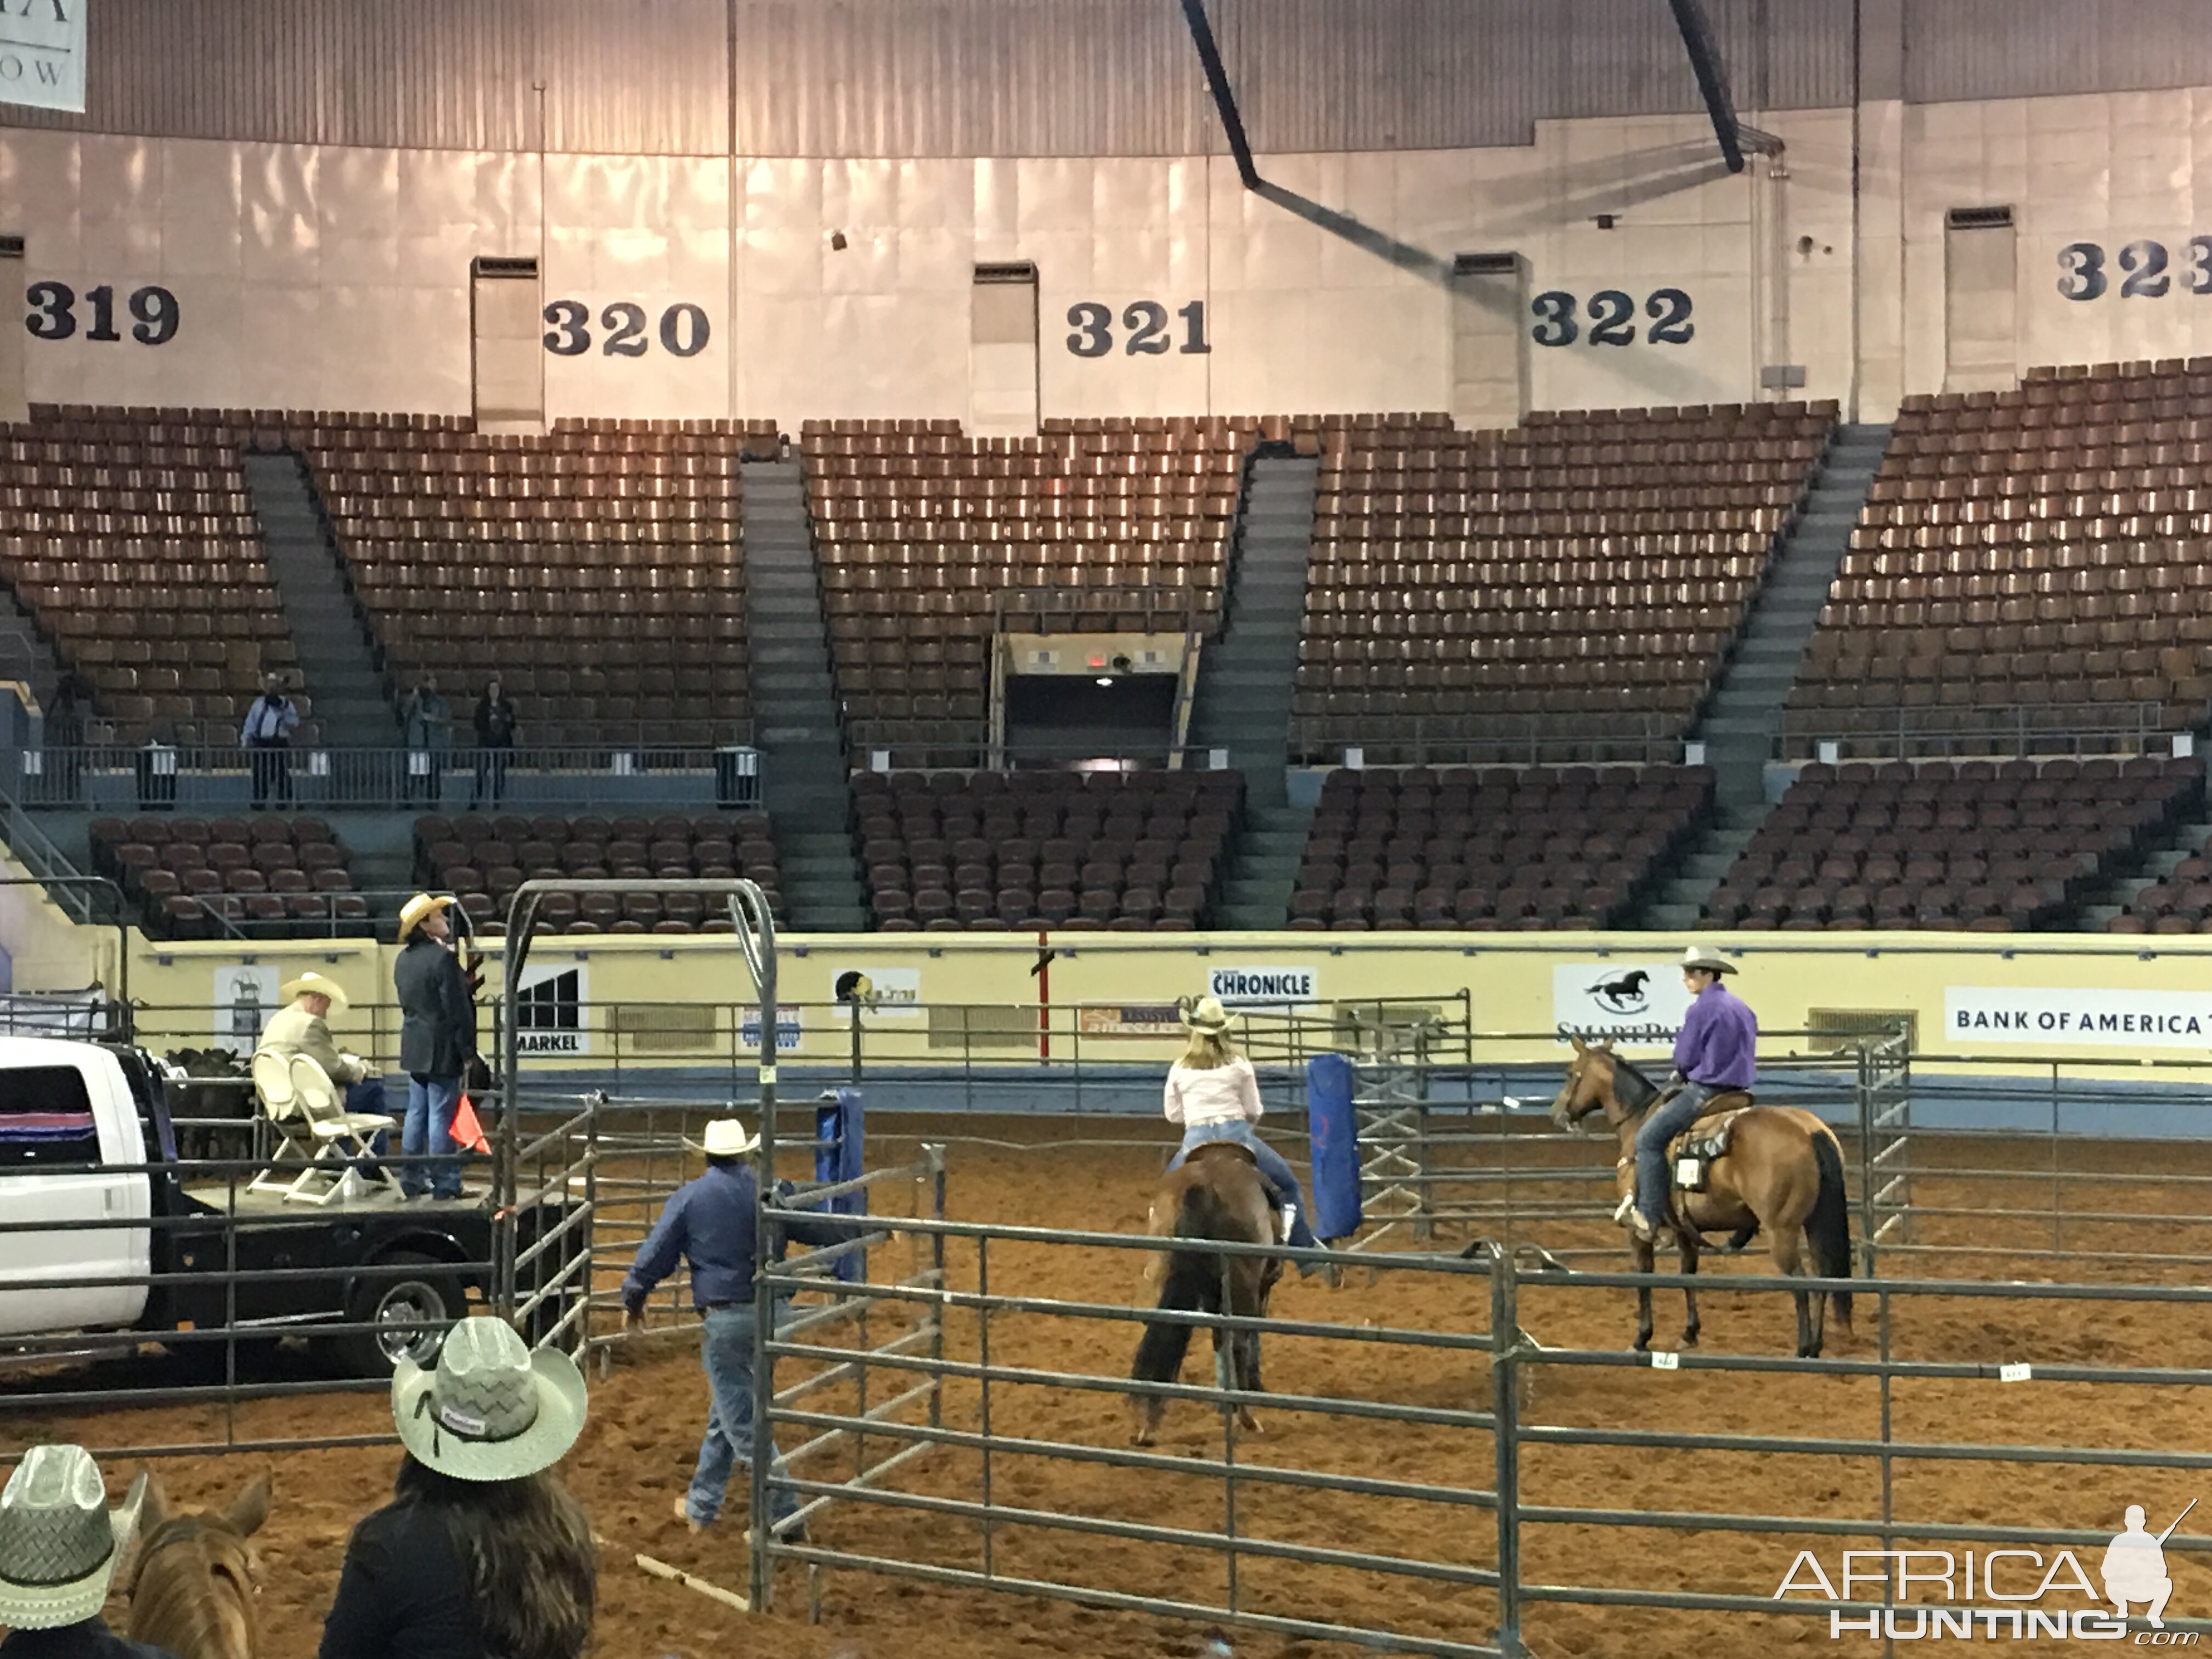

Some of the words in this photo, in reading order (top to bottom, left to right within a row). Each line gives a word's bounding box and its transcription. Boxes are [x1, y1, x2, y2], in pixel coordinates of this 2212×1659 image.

[26, 281, 179, 345] 319
[543, 300, 710, 357] 320
[1066, 300, 1211, 358] 321
[1531, 288, 1694, 347] 322
[1214, 974, 1310, 995] CHRONICLE
[1956, 1011, 2029, 1029] BANK
[2038, 1012, 2070, 1030] OF
[2079, 1013, 2202, 1034] AMERICA
